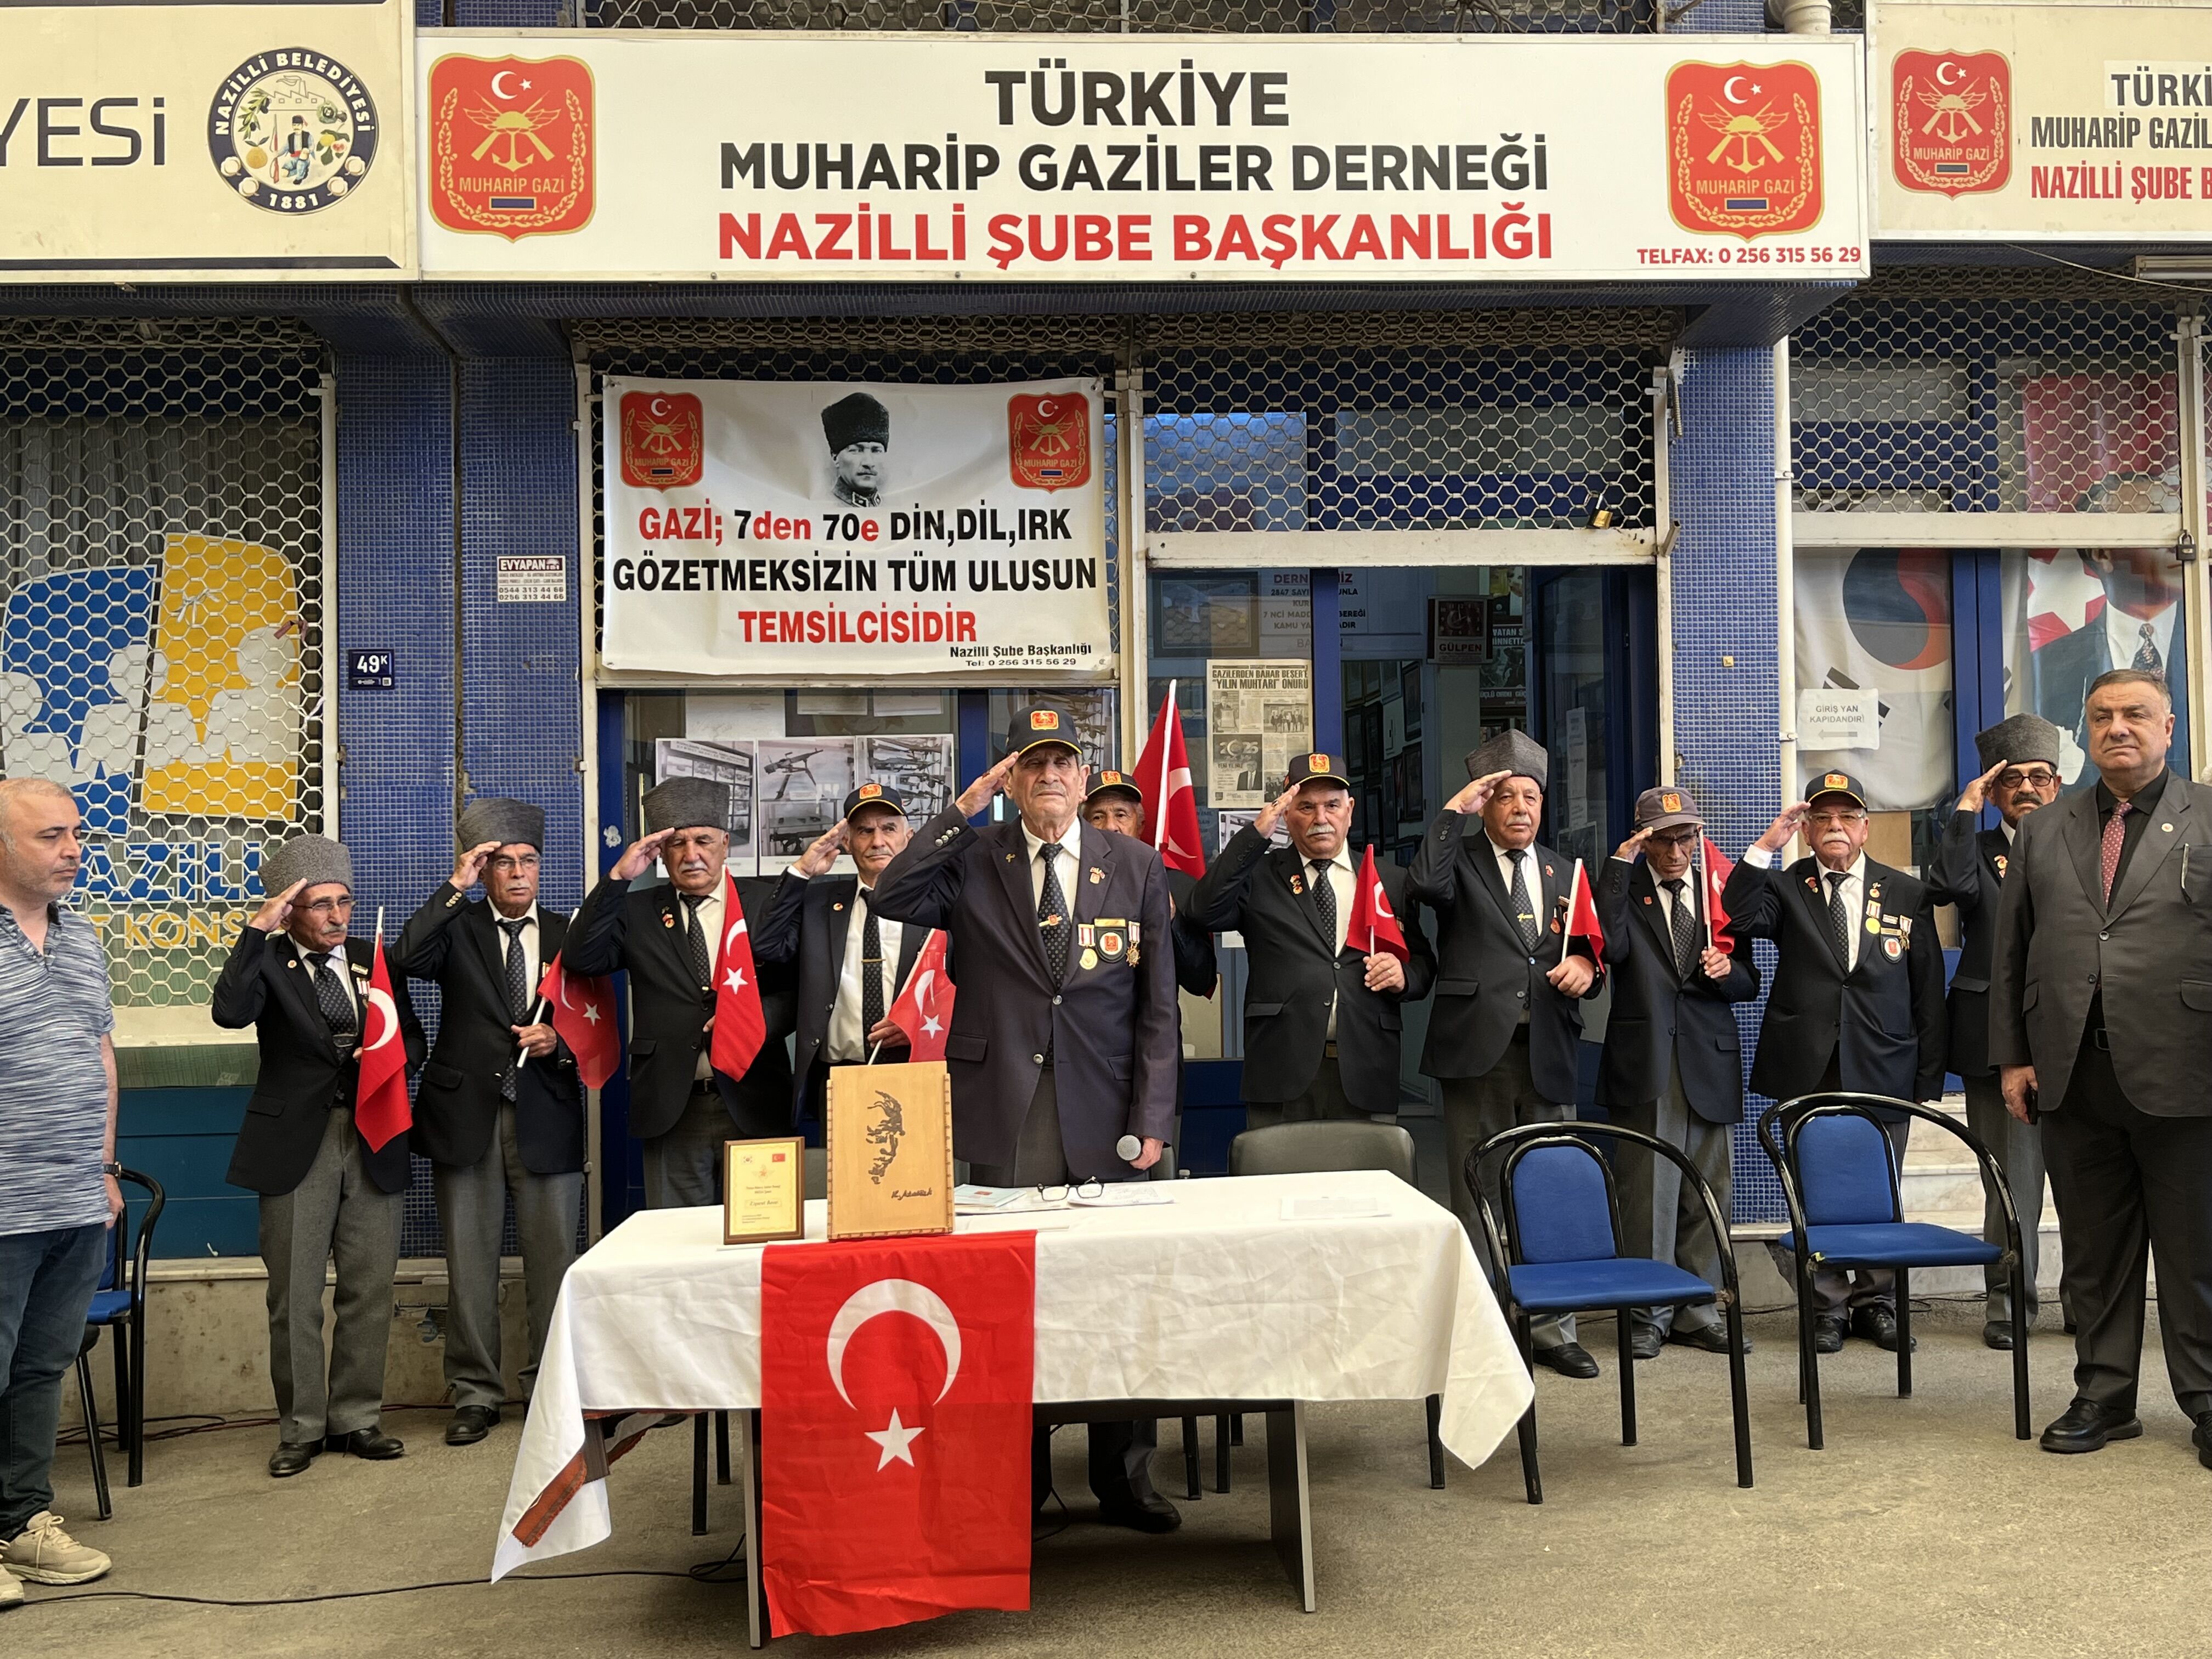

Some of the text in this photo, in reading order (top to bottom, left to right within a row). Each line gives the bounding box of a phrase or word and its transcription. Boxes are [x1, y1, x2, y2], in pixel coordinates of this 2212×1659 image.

[215, 52, 375, 136] NAZİLLİ BELEDİYESİ
[985, 58, 1289, 126] TÜRKİYE
[2031, 111, 2141, 149] MUHARİP
[720, 133, 1547, 191] MUHARİP GAZİLER DERNEĞİ
[1914, 145, 1990, 161] MUHARİP GAZİ
[459, 174, 565, 194] MUHARİP GAZİ
[1697, 176, 1795, 194] MUHARİP GAZİ
[2031, 160, 2122, 198] NAZİLLİ
[2131, 166, 2192, 204] ŞUBE
[269, 192, 319, 210] 1881
[720, 202, 1551, 270] NAZİLLİ ŞUBE BAŞKANLIĞI
[1637, 246, 1860, 264] TELFAX: 0 256 315 56 29
[672, 458, 689, 466] GAZİ
[1060, 459, 1077, 467] GAZİ
[640, 498, 722, 546] GAZİ;
[735, 510, 811, 540] 7den
[823, 514, 878, 541] 70e
[500, 559, 546, 570] EVYAPAN
[613, 550, 1096, 591] GÖZETMEKSİZİN TÜM ULUSUN
[738, 602, 977, 643] TEMSİLCİSİDİR
[950, 643, 1091, 657] Nazilli Şube Başkanlığı
[1440, 642, 1481, 652] GÜLPEN
[1256, 670, 1279, 678] BAHAR
[1282, 679, 1308, 689] ONURU
[1816, 706, 1838, 714] GİRİŞ
